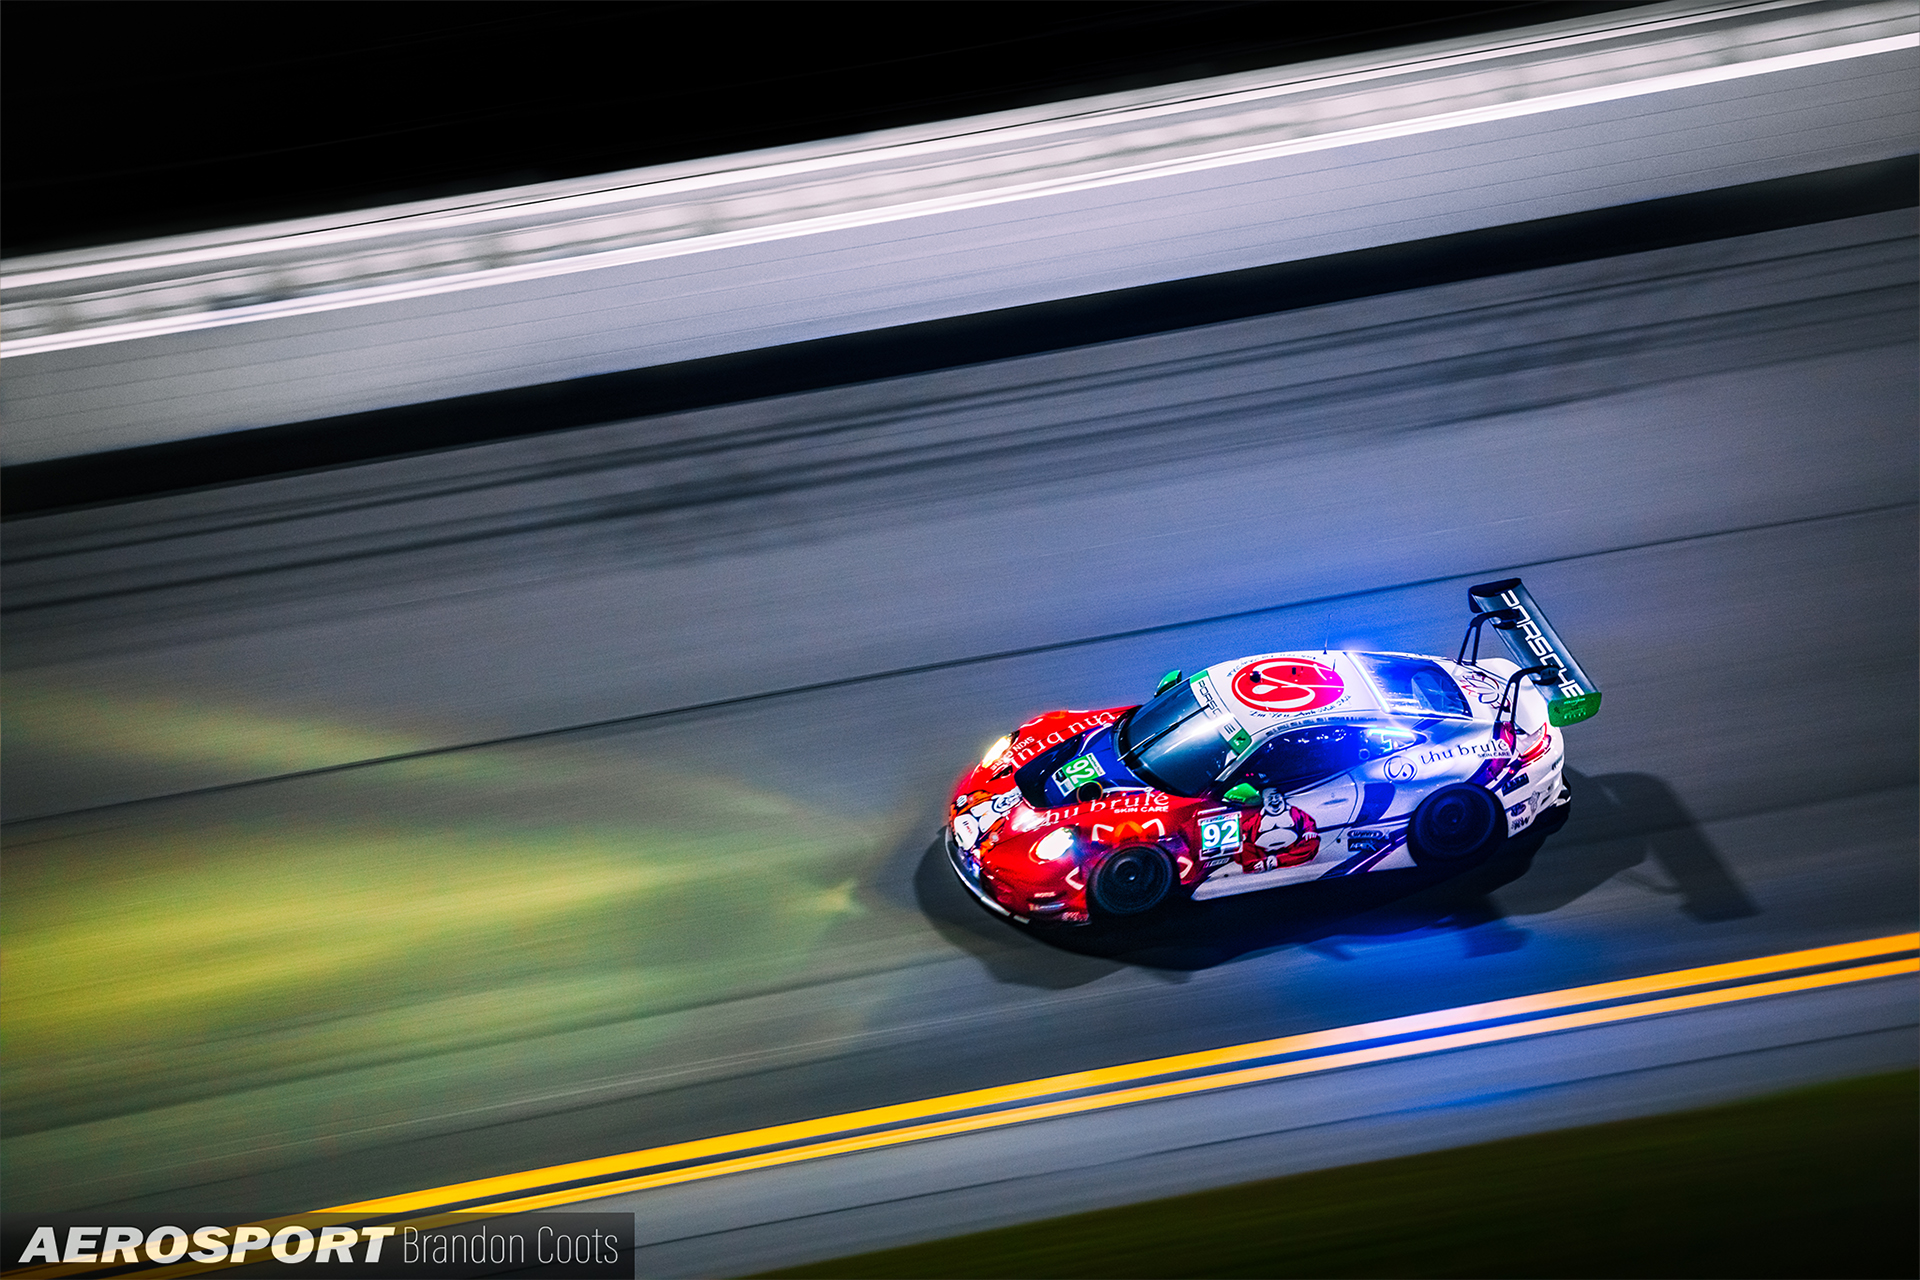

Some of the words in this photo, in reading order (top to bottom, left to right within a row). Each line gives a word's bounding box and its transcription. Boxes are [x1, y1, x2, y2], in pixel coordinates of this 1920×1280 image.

[1198, 680, 1236, 735] PORSCE
[1066, 759, 1096, 786] 92
[1140, 805, 1169, 813] CARE
[1203, 820, 1238, 848] 92
